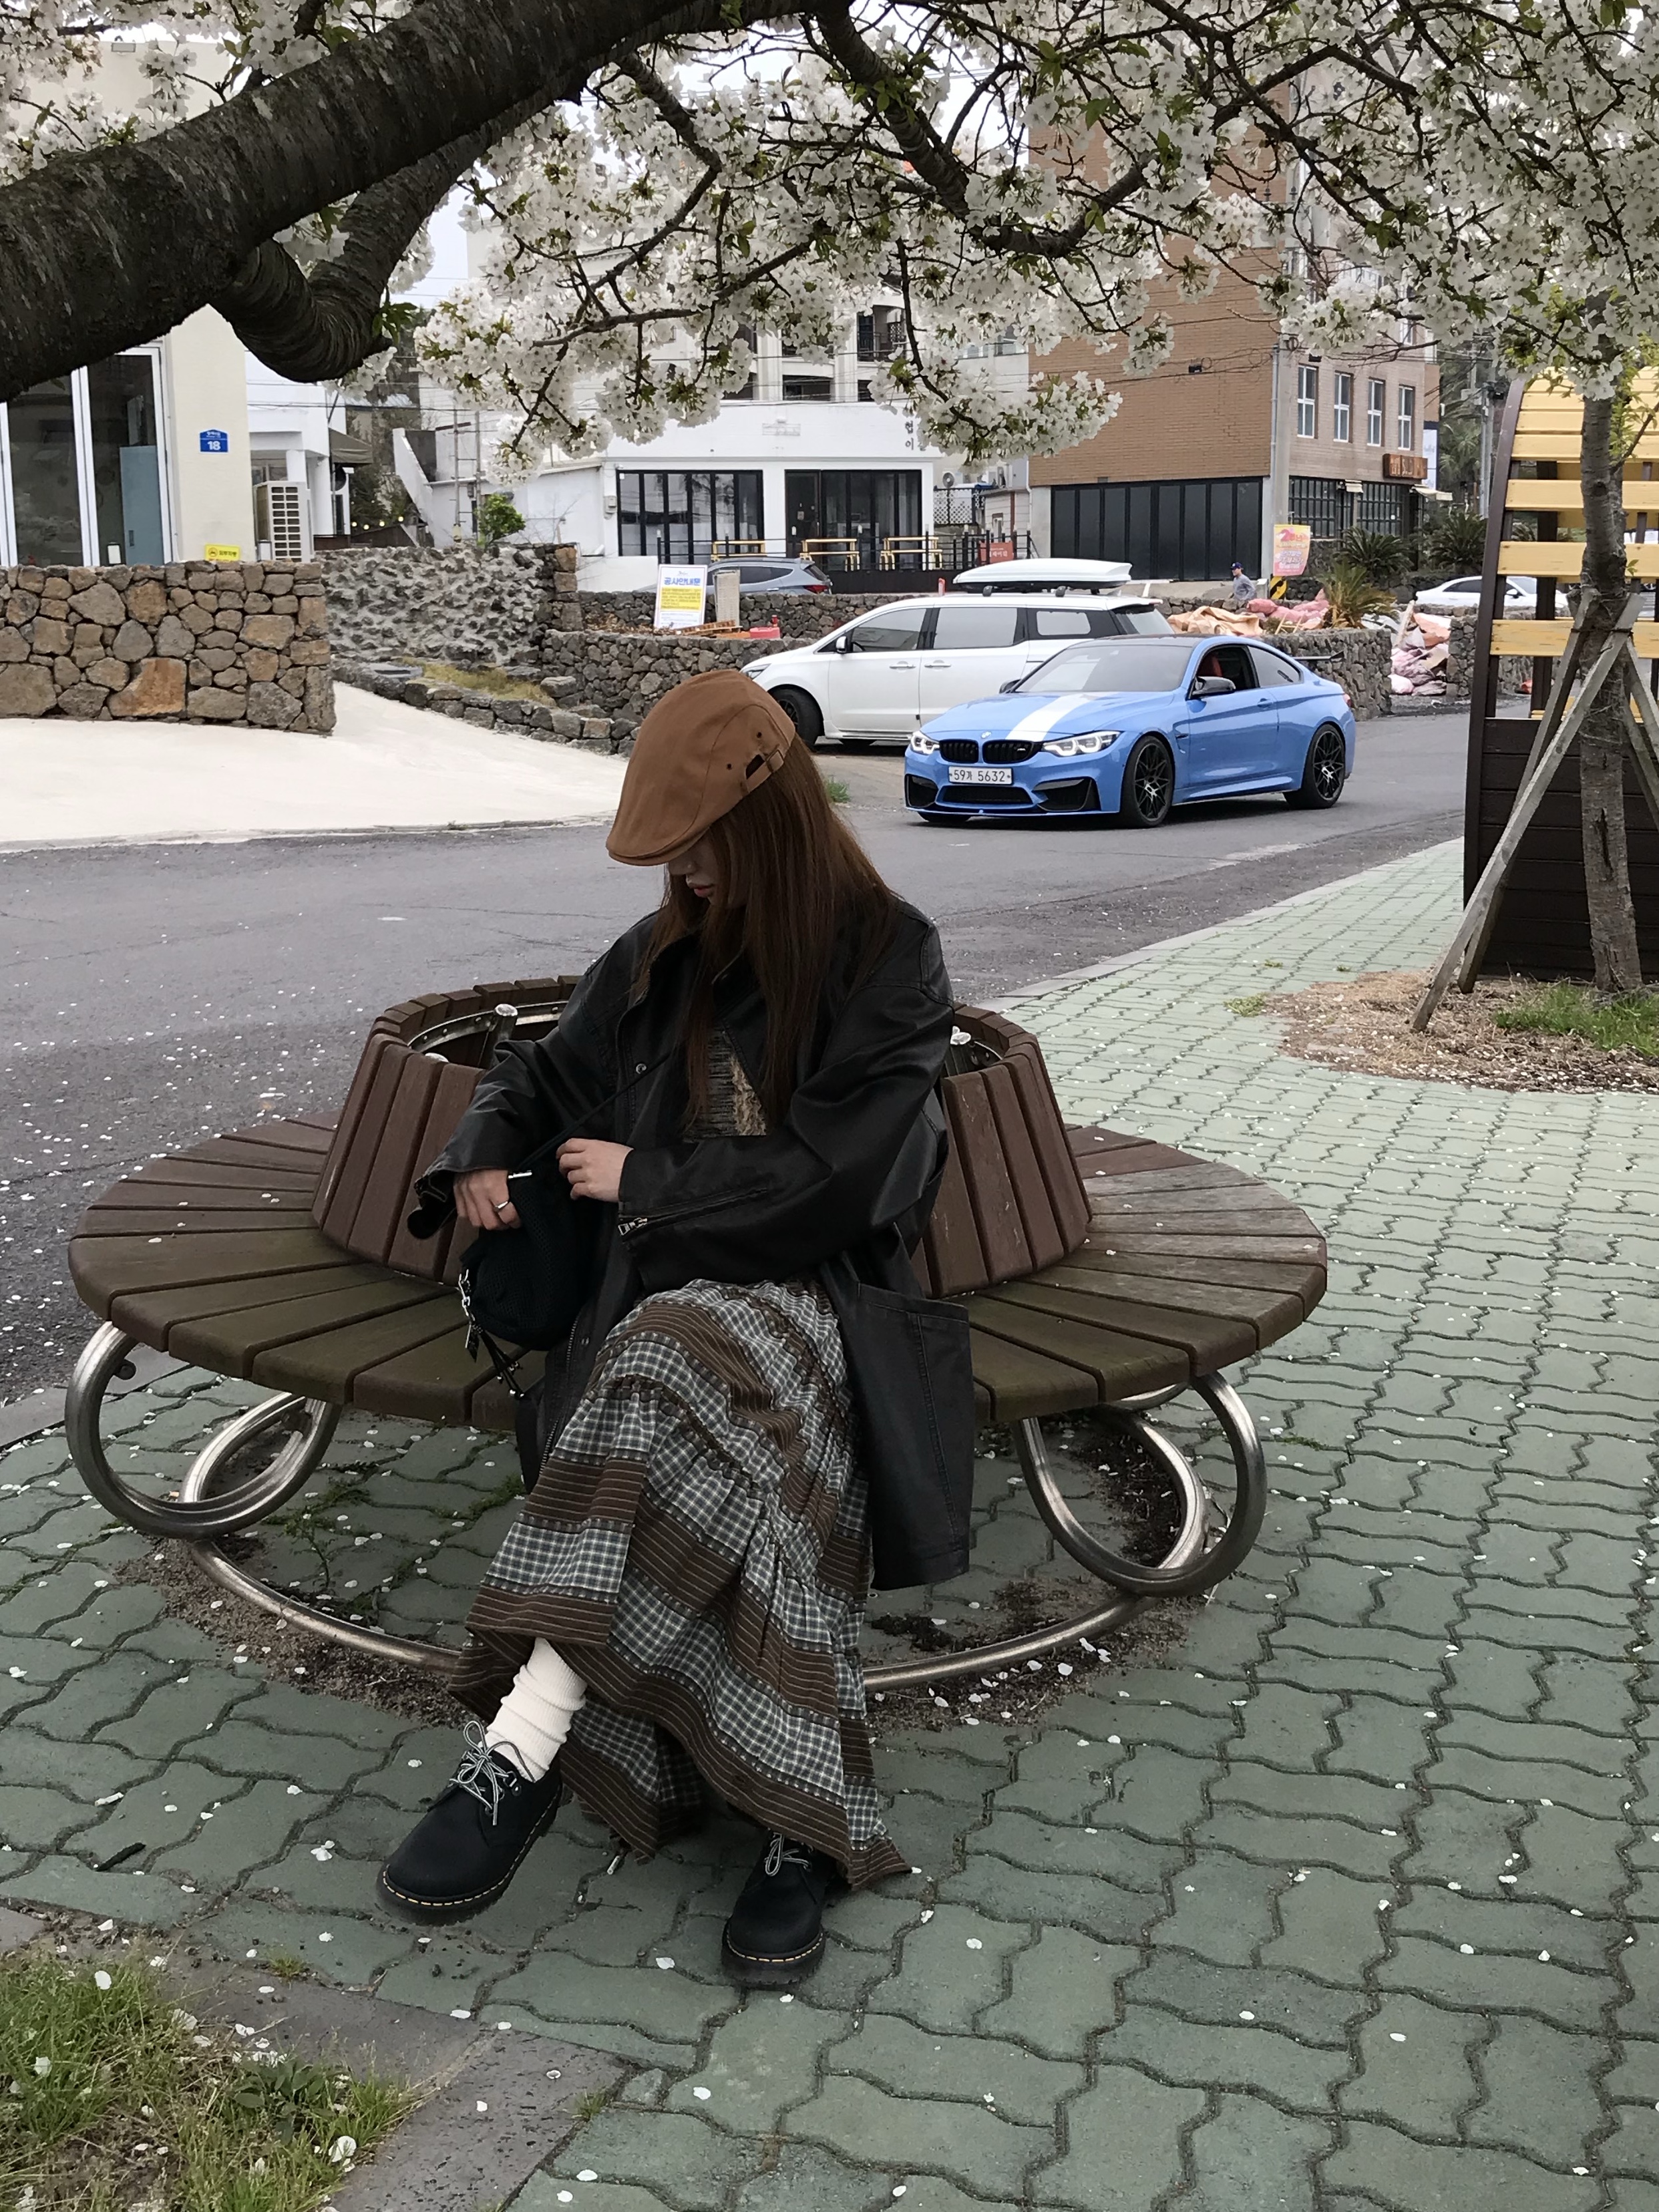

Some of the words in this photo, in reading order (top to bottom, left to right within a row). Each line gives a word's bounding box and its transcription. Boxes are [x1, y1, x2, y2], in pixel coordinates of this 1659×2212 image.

[207, 440, 221, 451] 18
[664, 576, 701, 586] 공사안내문
[978, 770, 1005, 782] 5632
